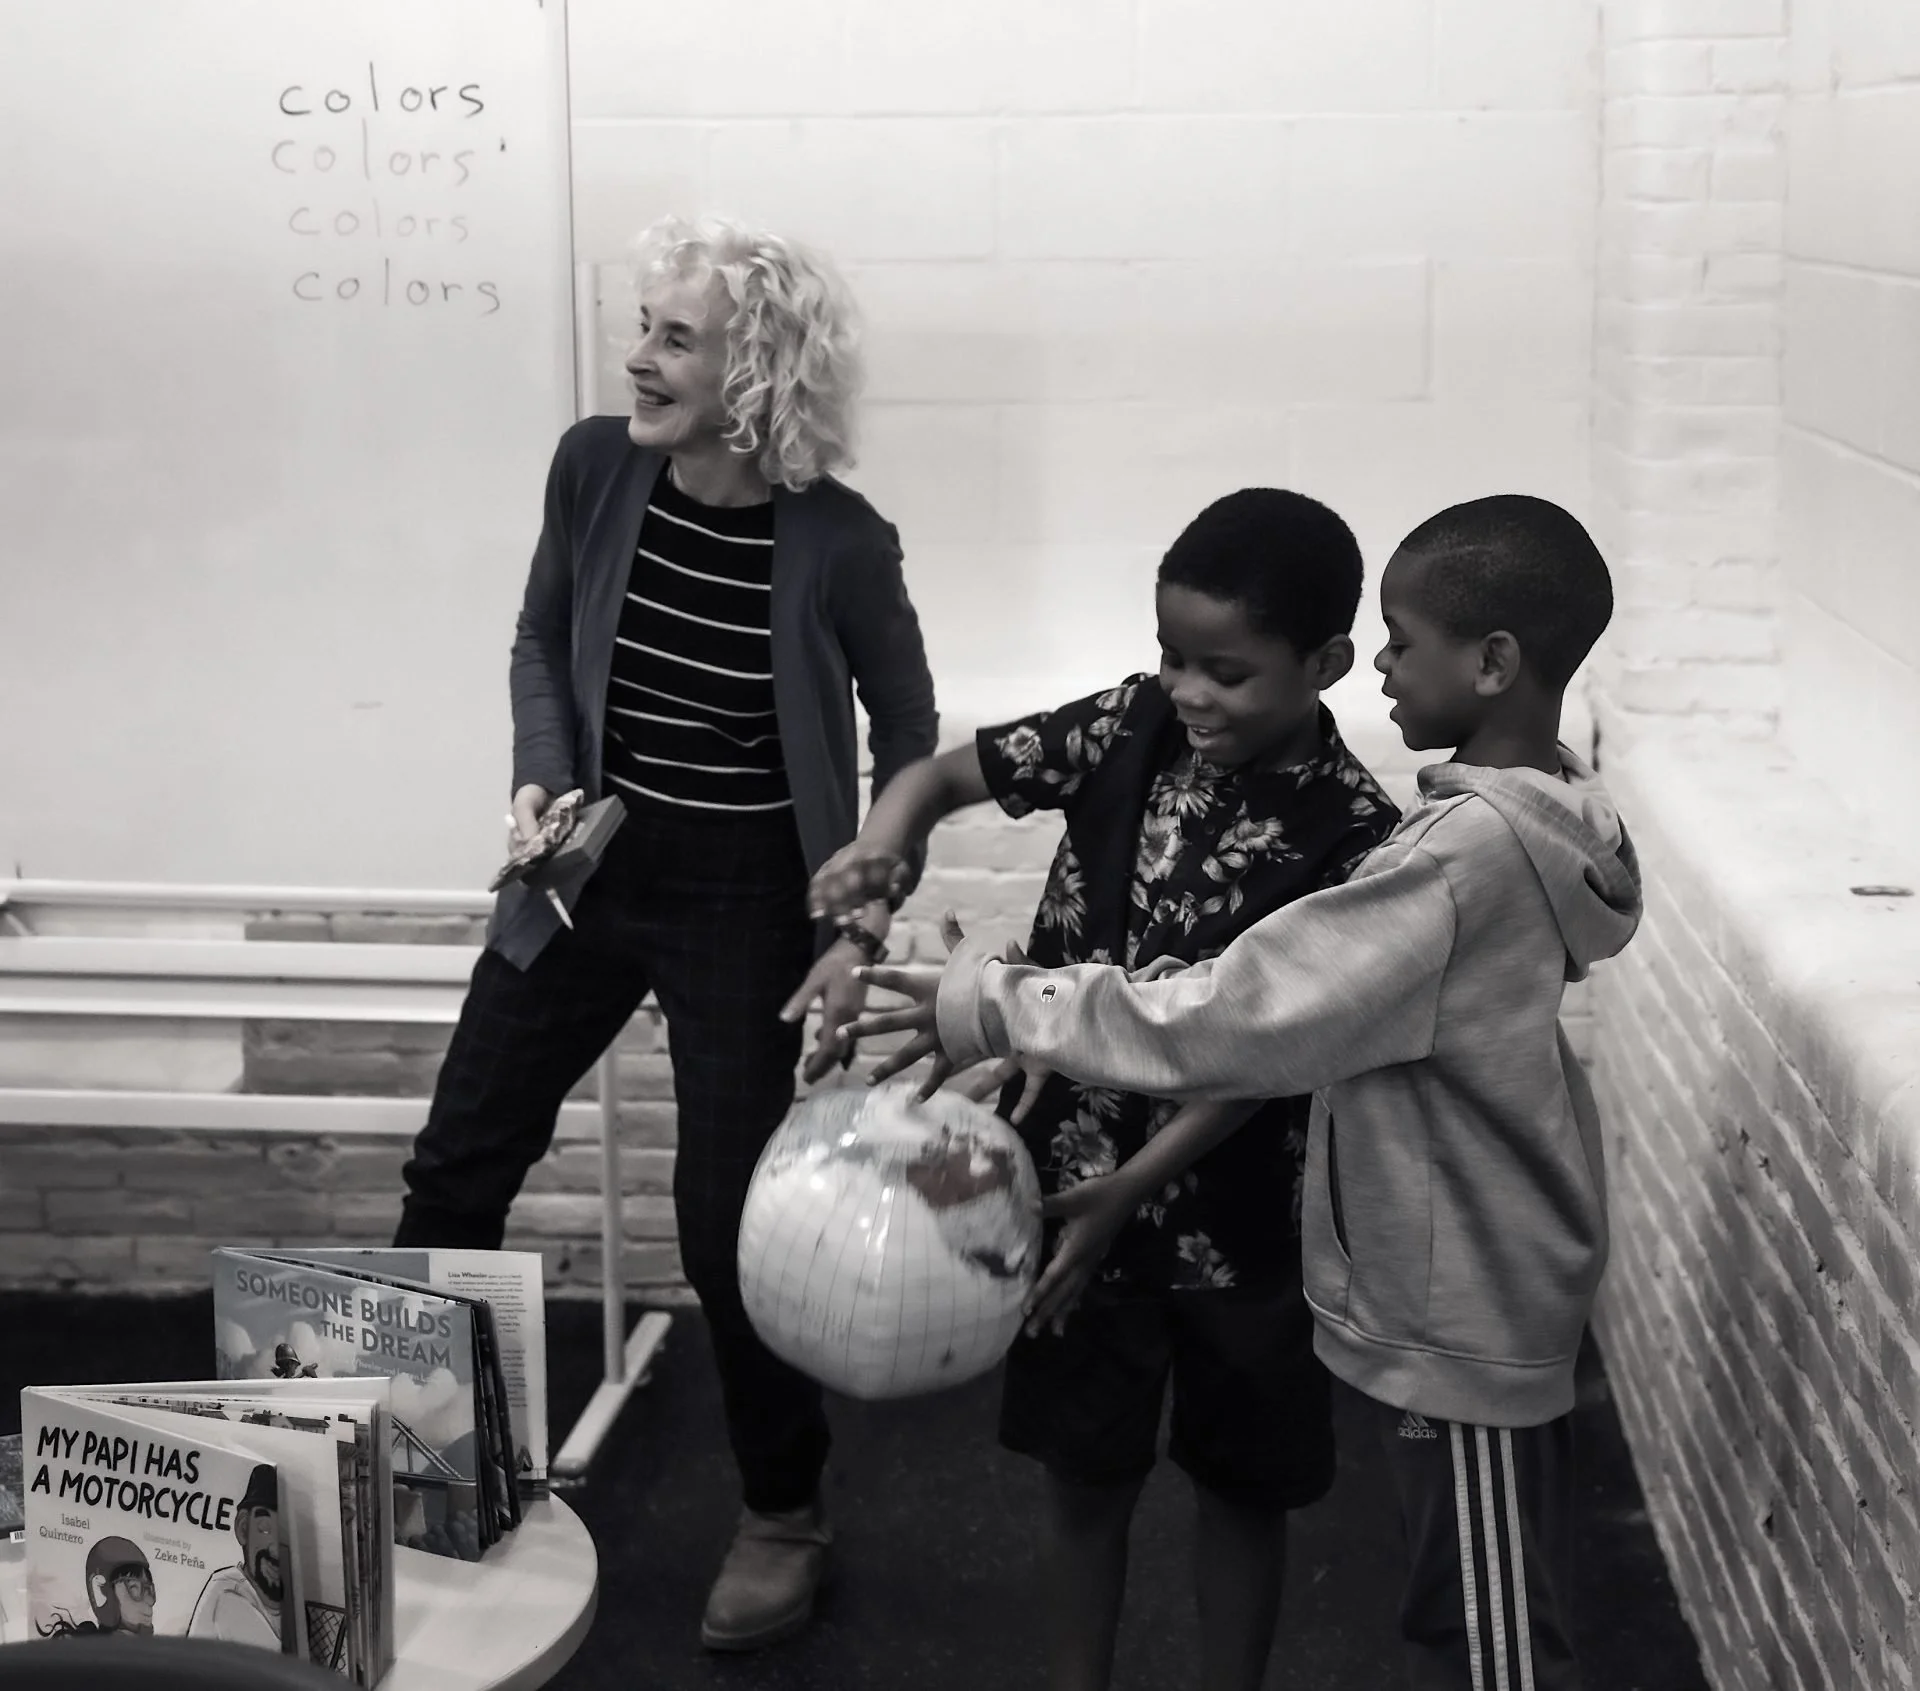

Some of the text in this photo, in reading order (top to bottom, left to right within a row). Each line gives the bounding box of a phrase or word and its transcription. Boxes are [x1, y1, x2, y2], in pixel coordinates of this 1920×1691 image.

[279, 61, 485, 118] colors
[288, 197, 469, 243] colors
[293, 257, 501, 318] colors
[236, 1270, 451, 1338] SOMEONE BUILDS
[320, 1320, 450, 1368] THE DREAM
[37, 1426, 200, 1484] MY PAPI HAS
[1398, 1427, 1437, 1439] adidas
[31, 1464, 235, 1532] A MOTORCYCLE
[61, 1513, 90, 1530] Isabel
[39, 1525, 84, 1545] Quintero
[154, 1548, 206, 1569] Zeke Peña
